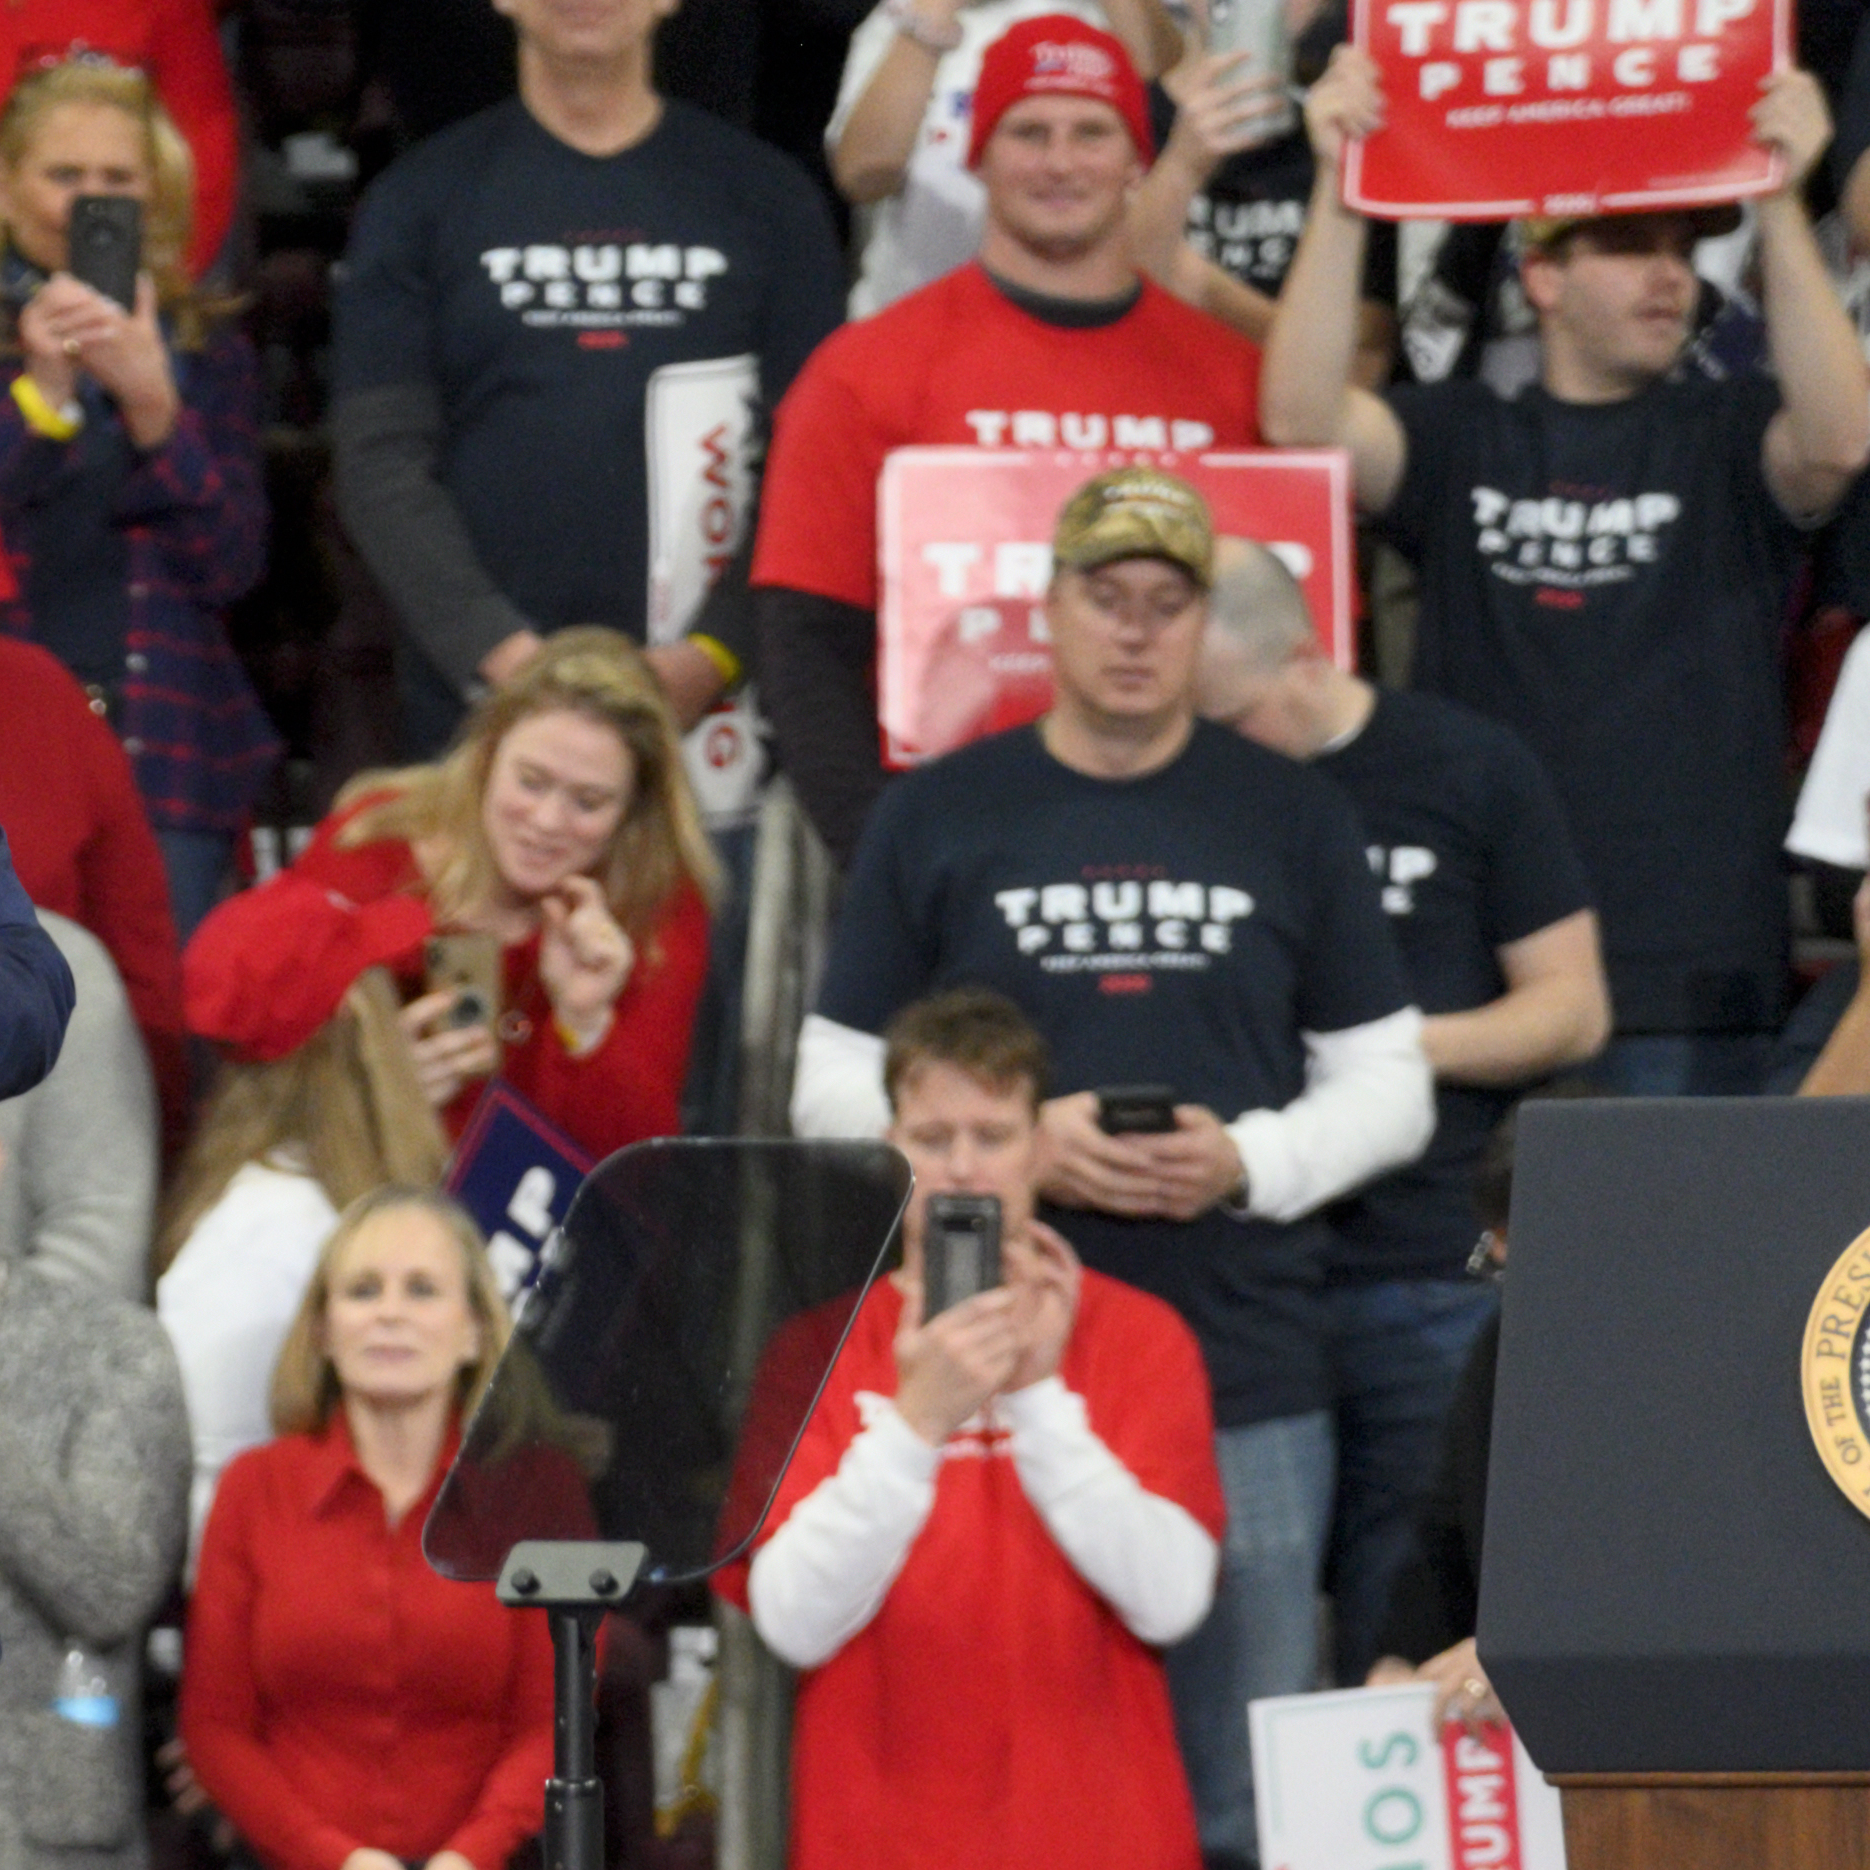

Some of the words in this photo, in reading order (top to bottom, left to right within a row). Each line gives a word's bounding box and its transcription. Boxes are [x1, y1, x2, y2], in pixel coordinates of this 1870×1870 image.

[1386, 0, 1757, 57] TRUMP
[1419, 44, 1723, 101] PENCE
[479, 244, 729, 284] TRUMP
[500, 281, 707, 311] PENCE
[965, 410, 1214, 452] TRUMP
[1470, 486, 1682, 540] TRUMP
[1476, 529, 1657, 569] PENCE
[994, 881, 1255, 926] TRUMP
[1017, 918, 1232, 954] PENCE
[1819, 1376, 1846, 1427] THE
[1834, 1437, 1861, 1466] OF
